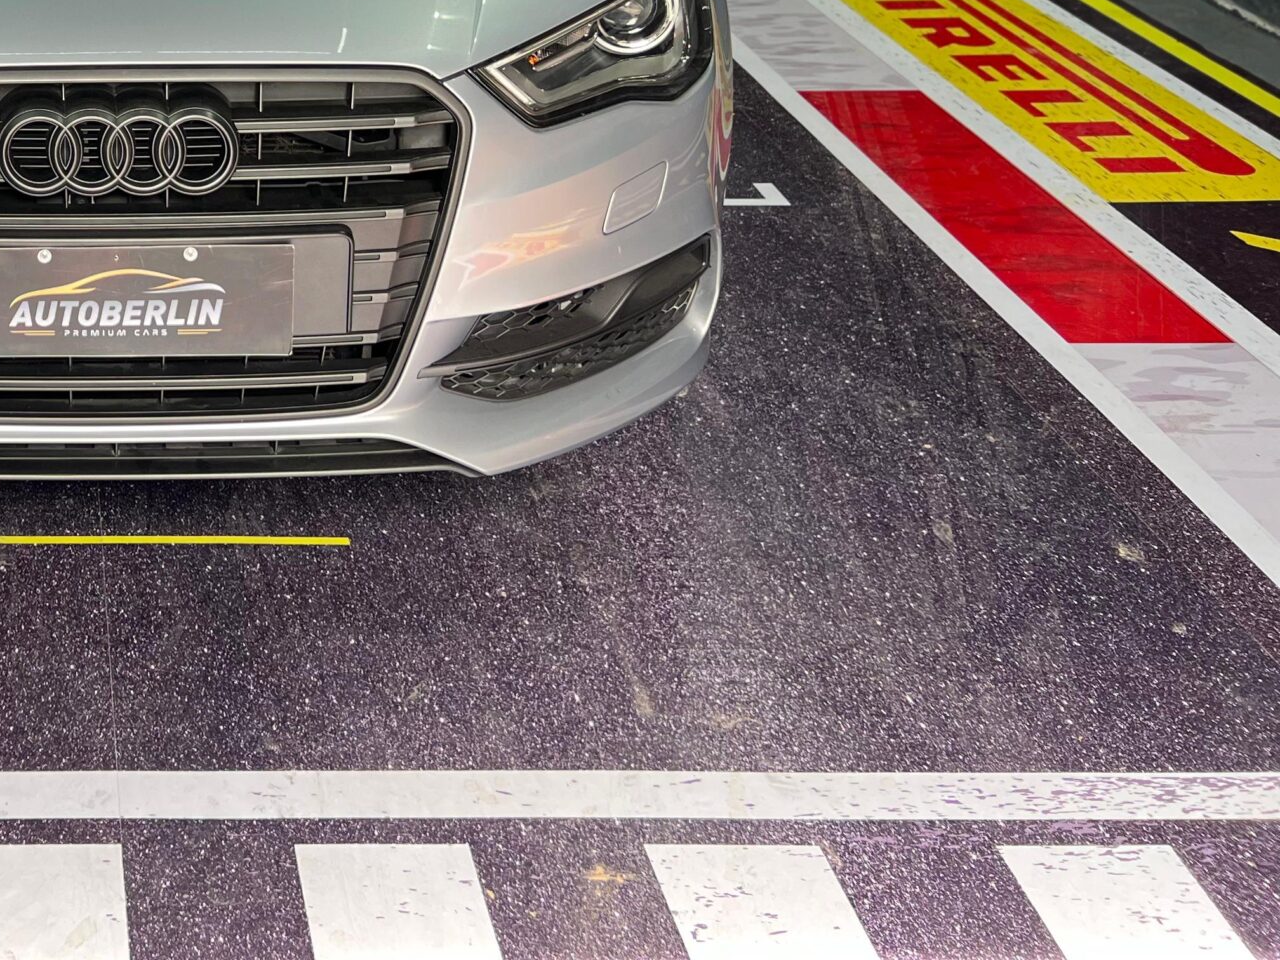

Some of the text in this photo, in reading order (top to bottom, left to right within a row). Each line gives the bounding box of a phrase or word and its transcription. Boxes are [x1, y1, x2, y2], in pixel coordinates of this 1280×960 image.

[9, 298, 224, 328] AUTOBERLIN
[63, 328, 168, 338] PREMIUM CARS
